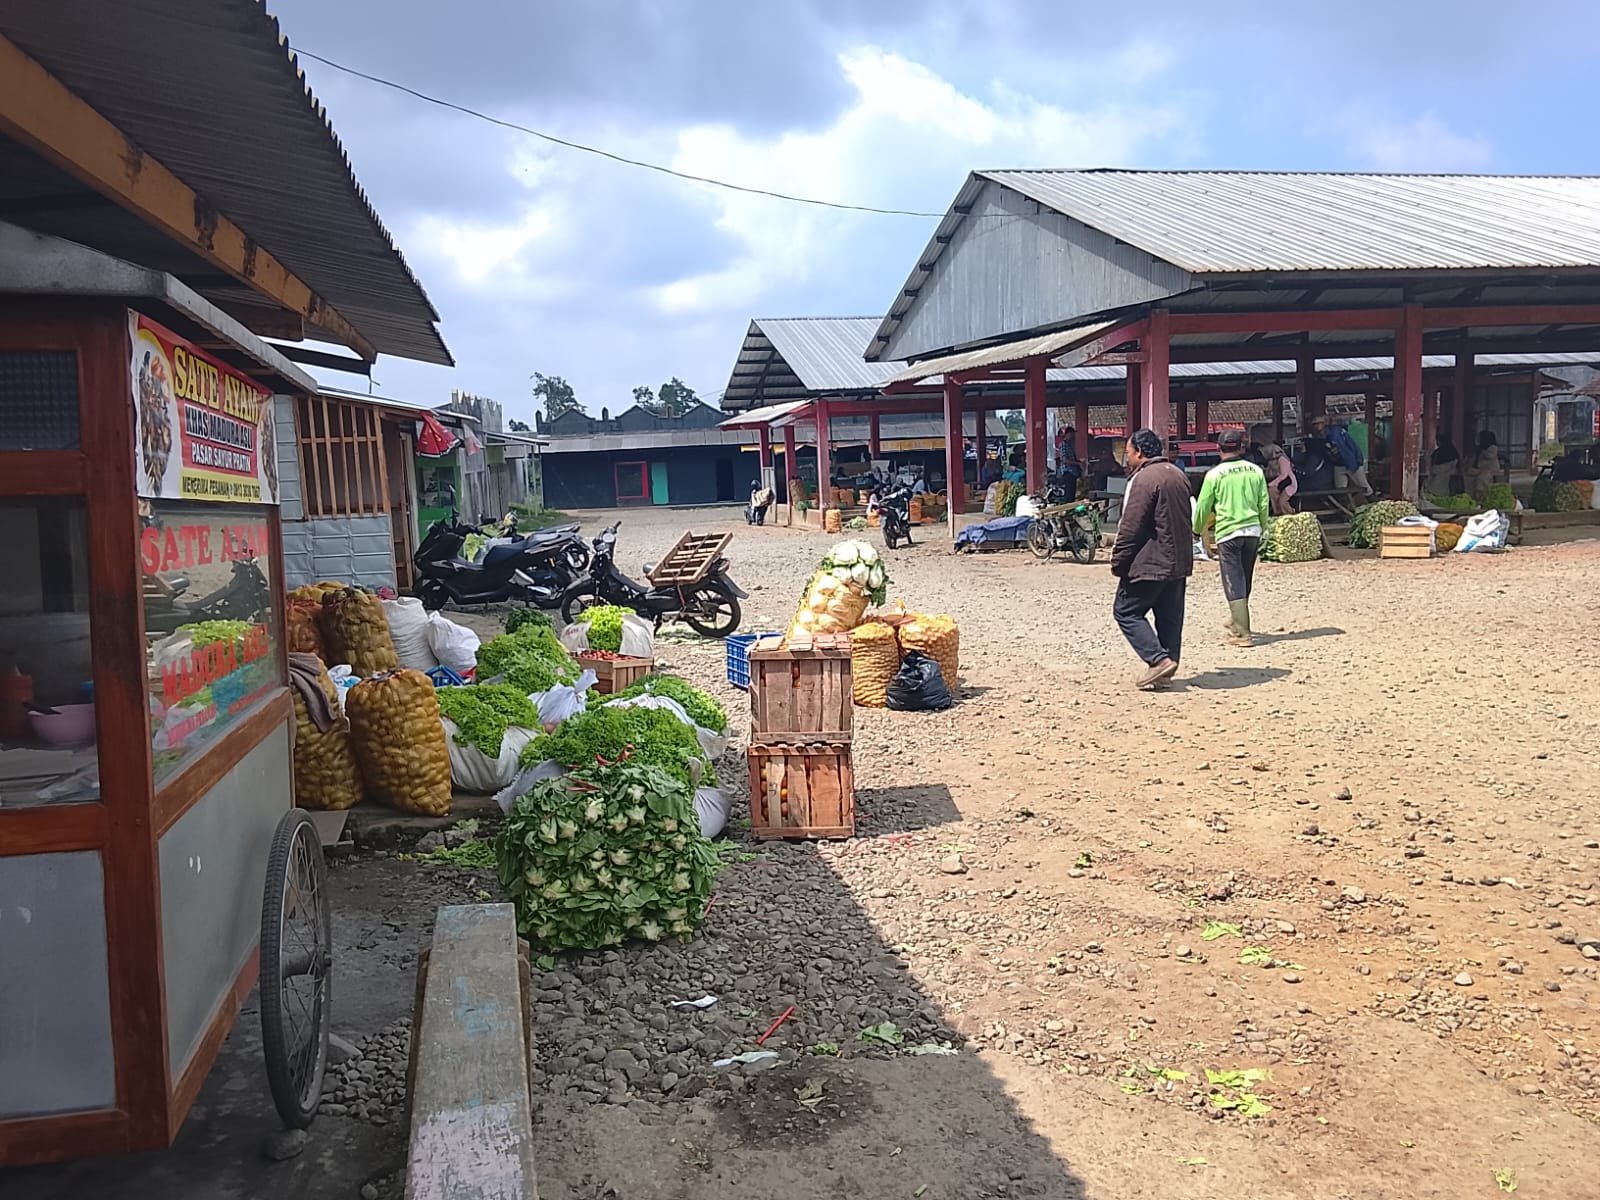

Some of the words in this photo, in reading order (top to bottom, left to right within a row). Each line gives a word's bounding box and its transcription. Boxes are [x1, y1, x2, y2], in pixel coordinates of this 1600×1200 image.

[173, 346, 219, 410] SATE
[223, 373, 259, 426] AYAM
[185, 404, 209, 438] KHAS
[209, 413, 239, 447] MADURA
[240, 425, 253, 450] ASLI
[191, 441, 213, 465] PASAR
[213, 447, 233, 469] SAYUR
[140, 524, 213, 576] SATE
[220, 525, 270, 563] AYAM
[162, 634, 238, 710] MADURA
